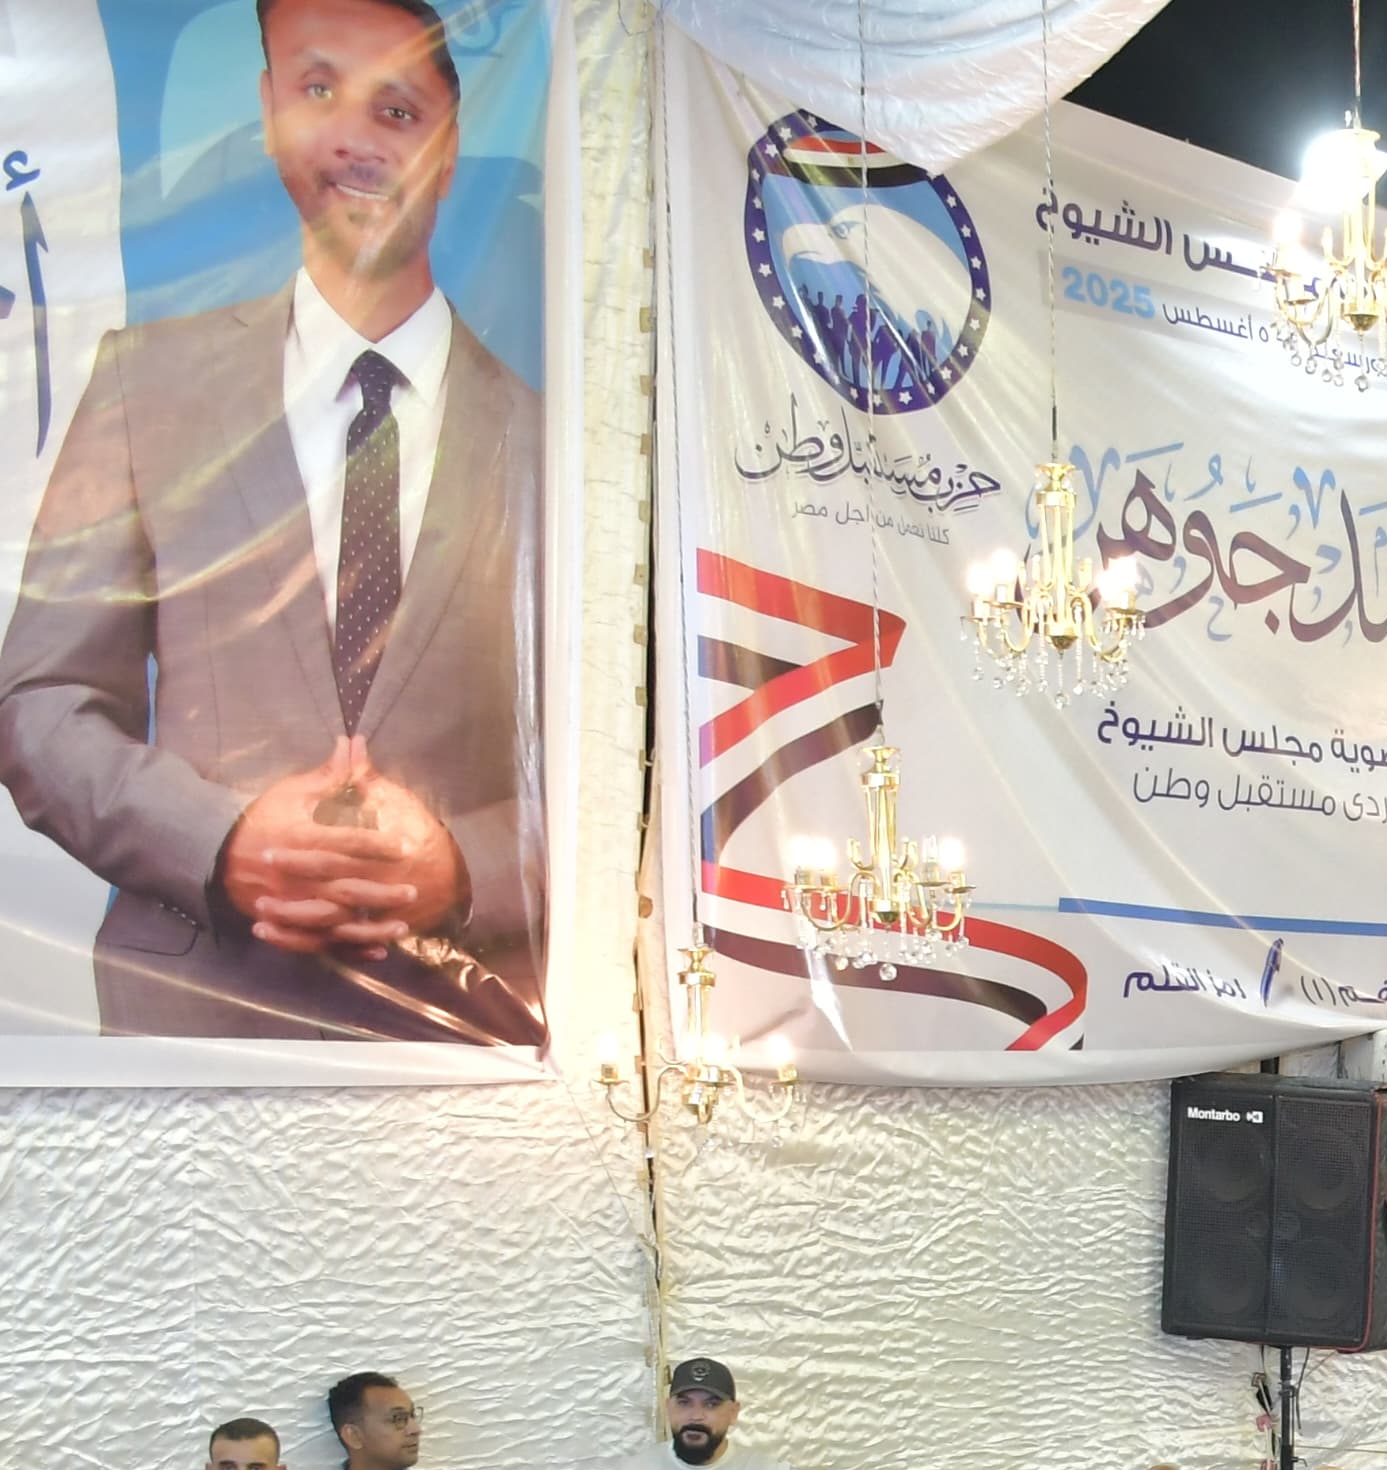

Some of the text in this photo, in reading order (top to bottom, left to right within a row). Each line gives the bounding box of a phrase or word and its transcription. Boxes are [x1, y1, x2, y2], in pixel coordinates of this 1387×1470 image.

[1035, 178, 1173, 256] الشيوخ
[1062, 265, 1156, 319] 2025
[1163, 302, 1254, 342] أغسطس
[734, 392, 843, 480] وطن
[908, 462, 1001, 514] حزب
[792, 500, 829, 520] مصر
[1097, 700, 1214, 752] الشيوخ
[1223, 725, 1324, 766] مجلس
[1133, 766, 1211, 808] وطن
[1218, 774, 1336, 816] مستقبل
[1187, 1106, 1241, 1123] Montarbo
